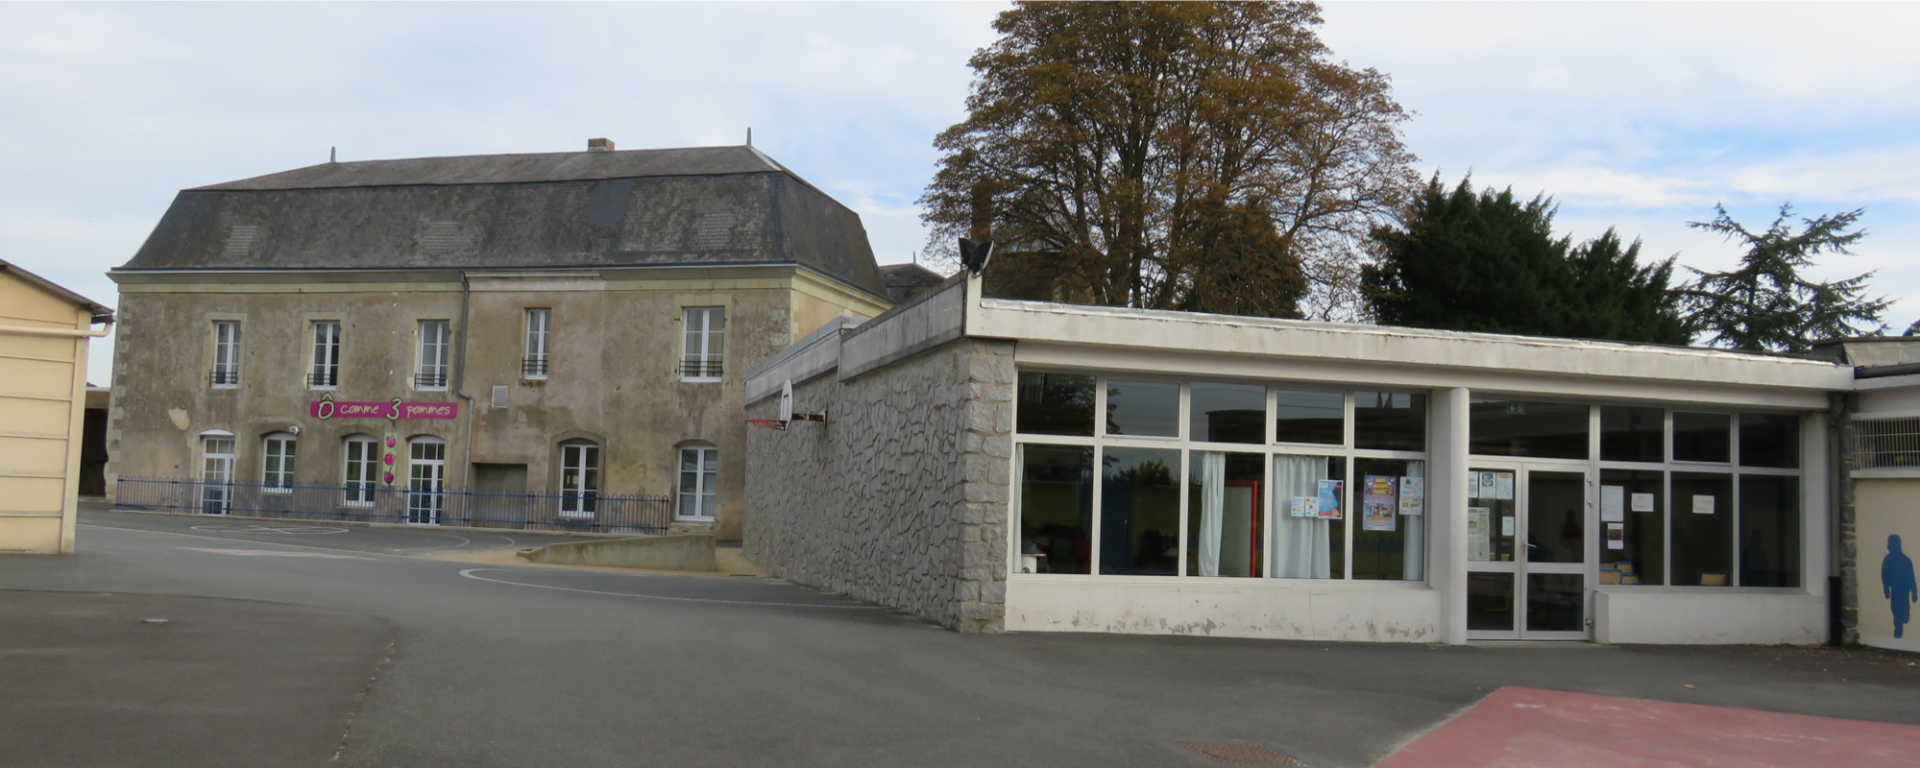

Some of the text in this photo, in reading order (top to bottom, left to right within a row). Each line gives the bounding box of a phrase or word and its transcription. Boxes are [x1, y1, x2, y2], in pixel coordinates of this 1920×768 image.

[318, 392, 451, 420] Ô comme 3 pommes
